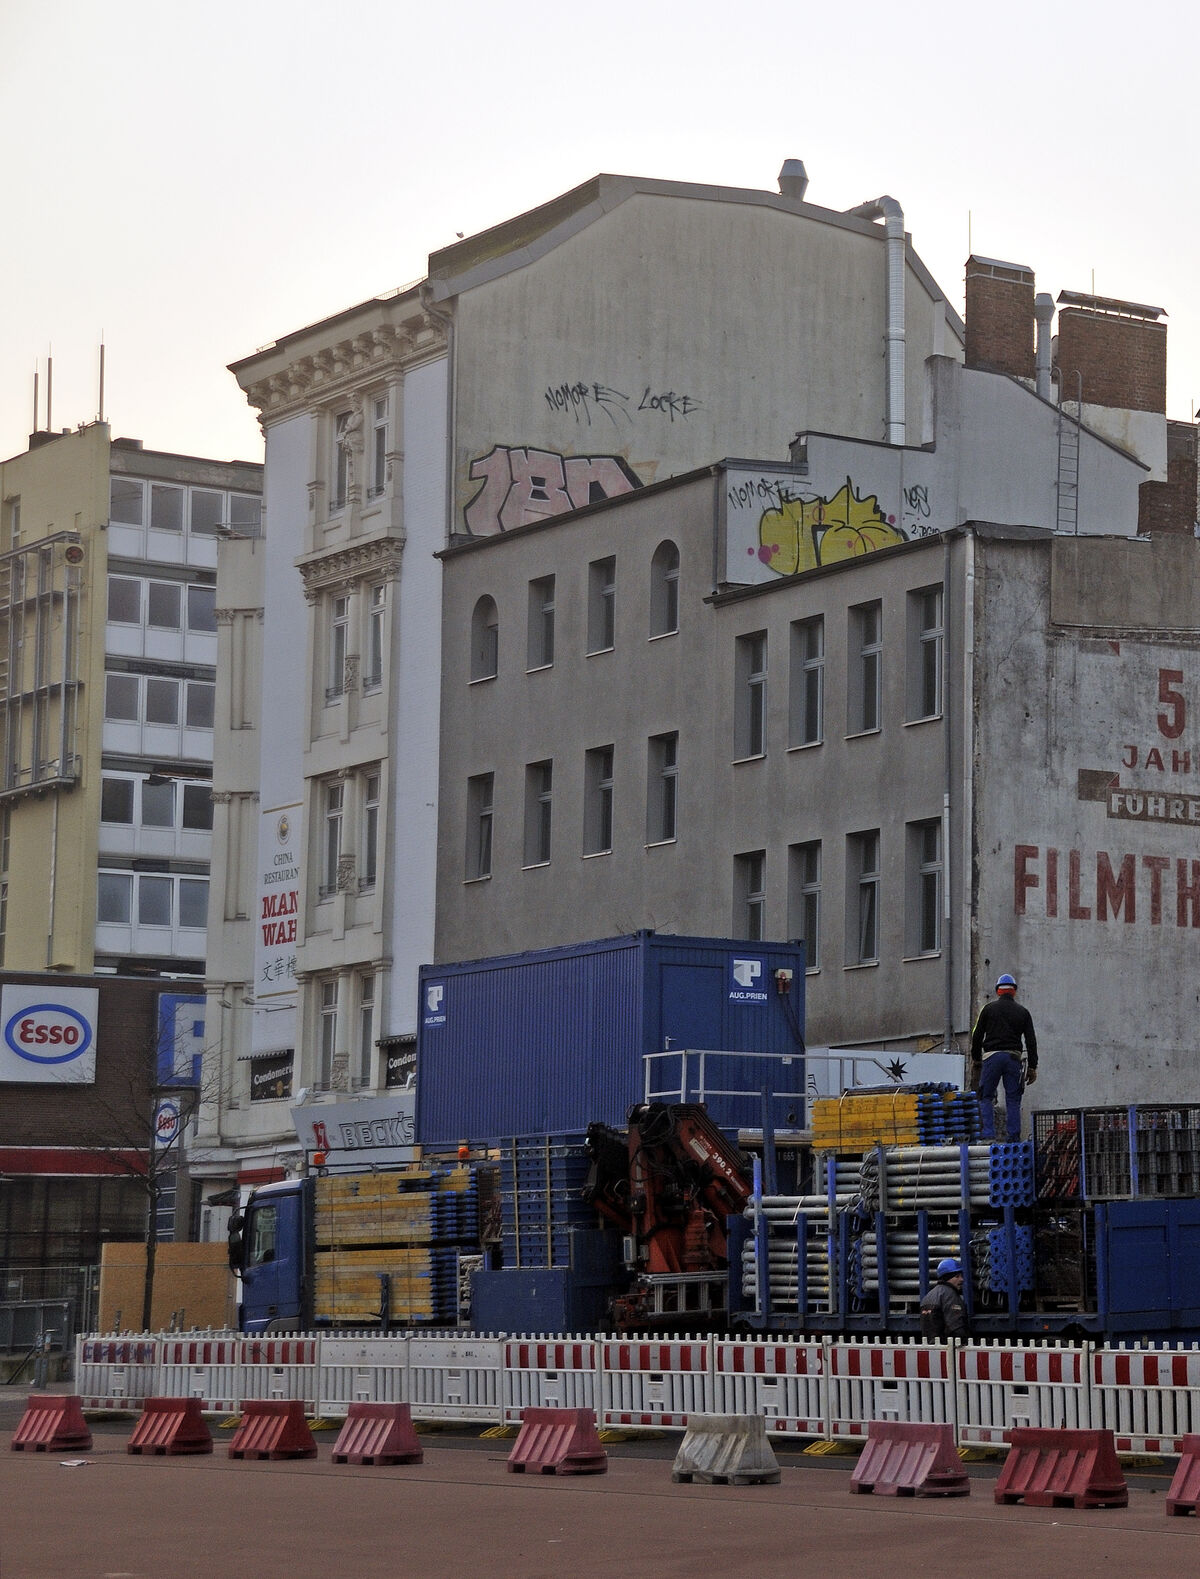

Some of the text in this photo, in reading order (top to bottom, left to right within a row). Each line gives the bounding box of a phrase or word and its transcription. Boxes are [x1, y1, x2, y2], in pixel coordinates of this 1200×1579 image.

[274, 851, 293, 867] CHINA
[264, 867, 300, 885] RESTAURAN
[729, 990, 768, 1001] AUG.PRIEN
[339, 1110, 416, 1149] BECK'S
